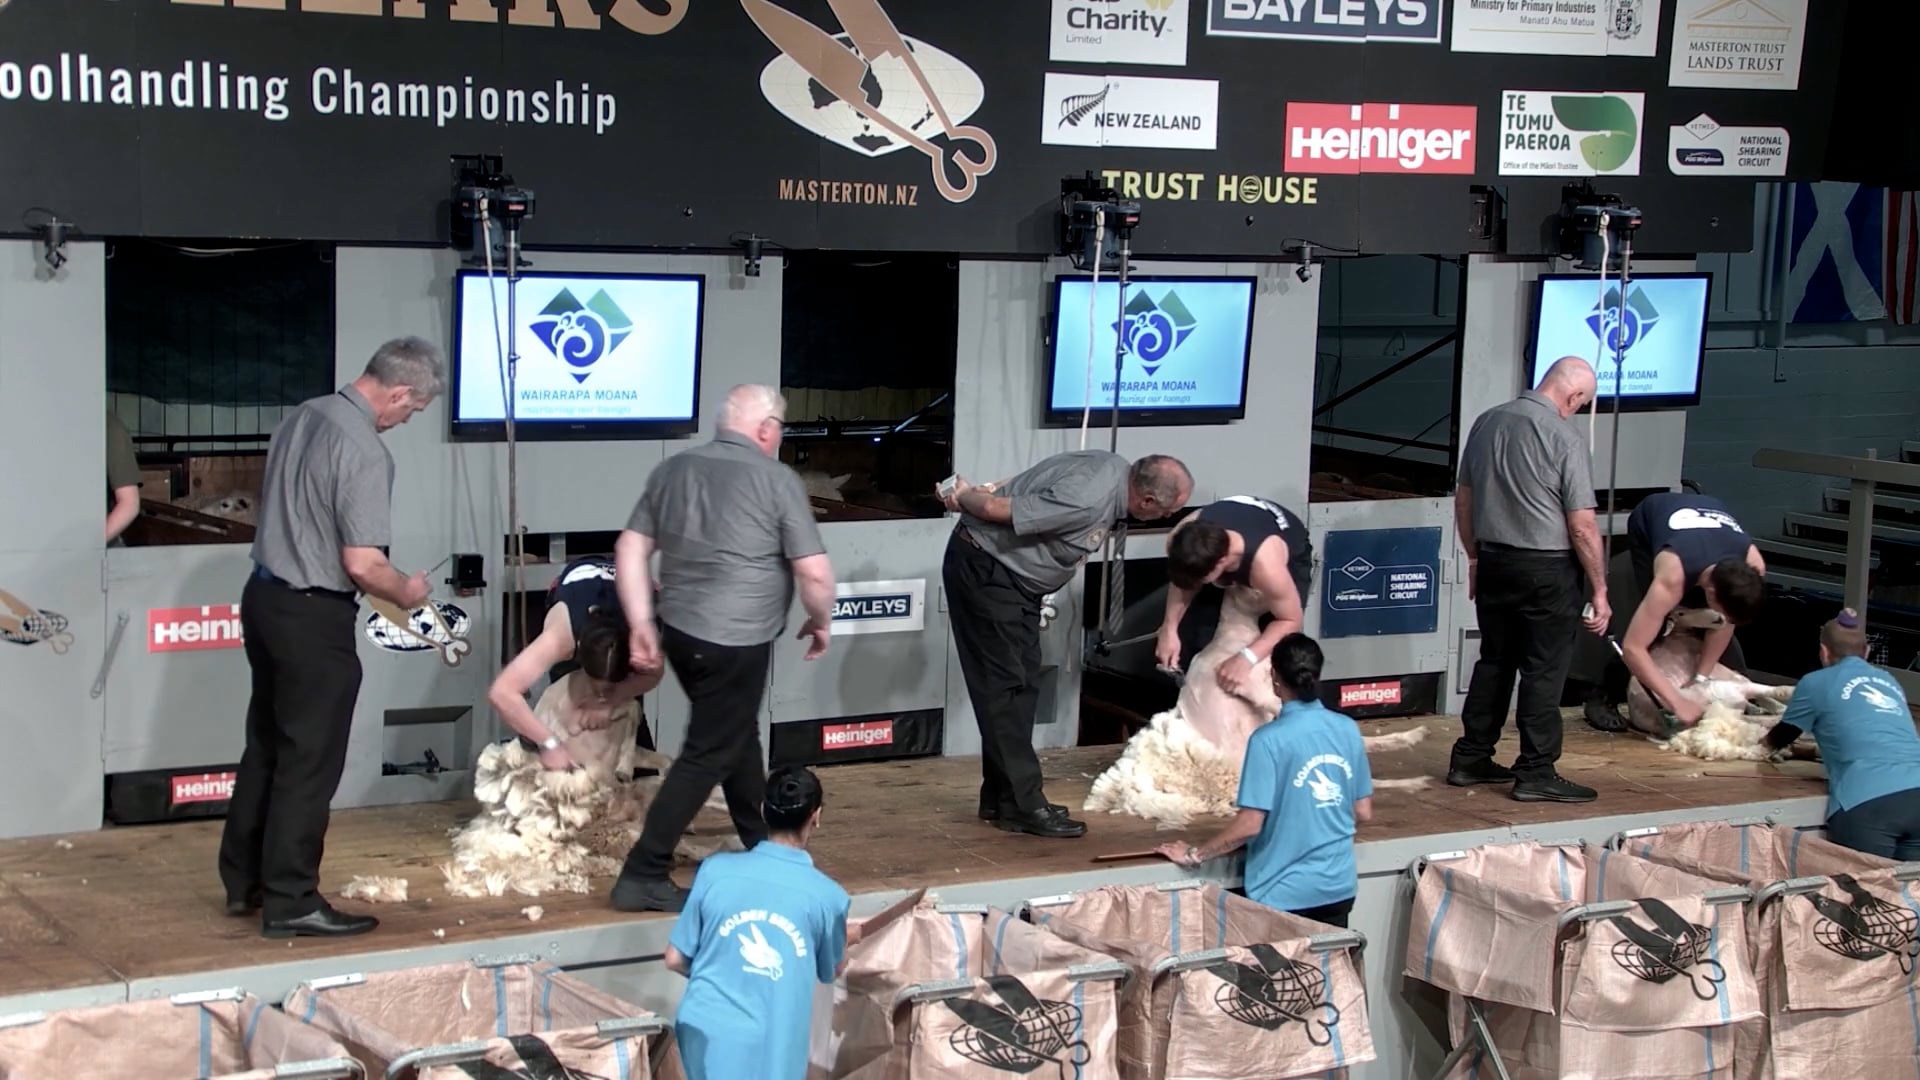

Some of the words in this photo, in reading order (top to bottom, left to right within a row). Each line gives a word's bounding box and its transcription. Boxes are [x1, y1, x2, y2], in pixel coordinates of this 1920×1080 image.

[1507, 0, 1518, 11] for
[1521, 0, 1554, 14] Primary
[1556, 1, 1596, 13] Industries
[1066, 34, 1102, 45] Limited
[1689, 41, 1752, 53] MASTERTON
[1754, 43, 1786, 54] TRUST
[1687, 56, 1734, 70] LANDS
[1738, 57, 1784, 71] TRUST
[0, 52, 289, 120] oolhandling
[311, 66, 616, 134] Championship
[1507, 94, 1526, 111] TE
[1094, 112, 1130, 128] NEW
[1133, 113, 1201, 131] ZEALAND
[1506, 114, 1553, 131] TUMU
[1291, 103, 1471, 169] Heiniger
[1505, 133, 1571, 151] PAEROA
[1740, 136, 1782, 145] NATIONAL
[1738, 147, 1781, 156] SHEARING
[1738, 157, 1770, 167] CIRCUIT
[779, 178, 918, 205] MASTERTON.NZ
[1102, 169, 1204, 200] TRUST
[1218, 174, 1318, 204] HOUSE
[1627, 370, 1658, 380] MOANA
[1101, 381, 1158, 393] WARARAPA
[1161, 380, 1197, 392] MOANA
[521, 389, 591, 401] WAIRARAPA
[595, 389, 638, 401] MOANA
[1390, 572, 1428, 582] NATIONAL
[1390, 581, 1428, 591] SHEARING
[1389, 590, 1419, 600] CIRCUIT
[154, 603, 244, 645] Heini
[1341, 682, 1399, 703] Heiniger
[824, 721, 891, 744] Heiniger
